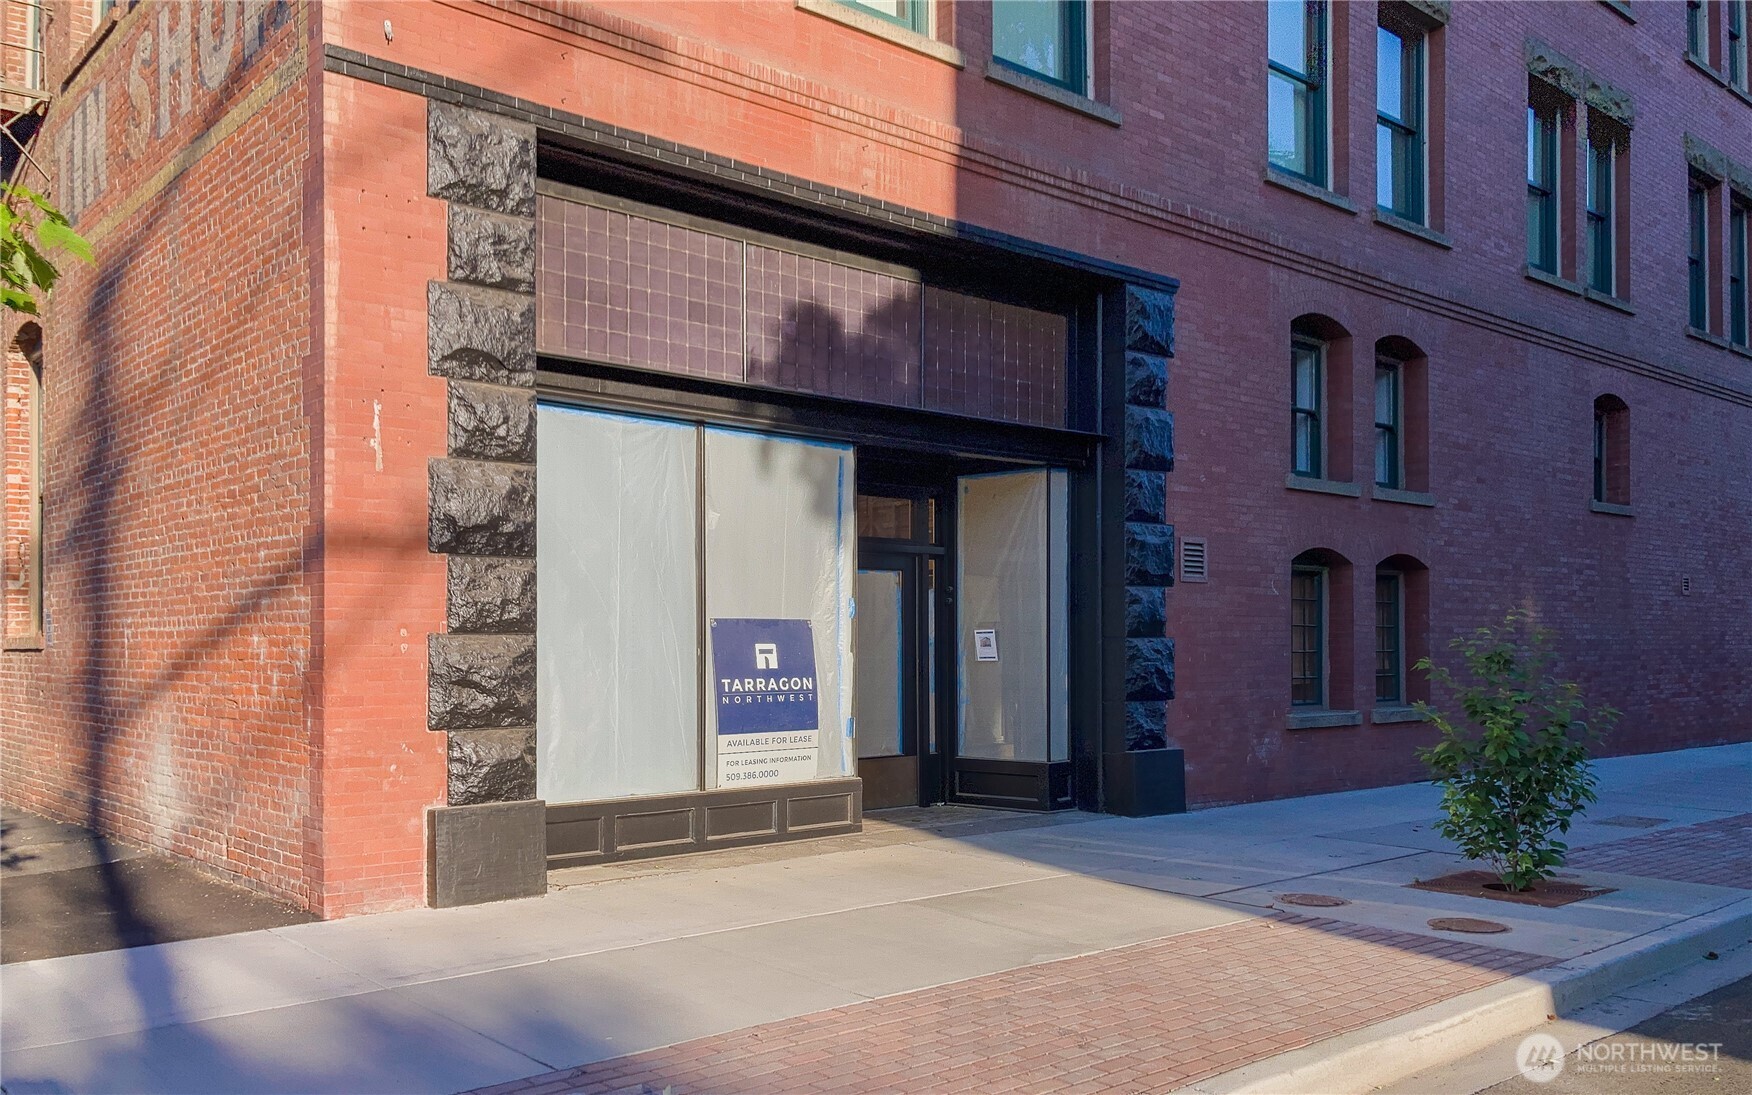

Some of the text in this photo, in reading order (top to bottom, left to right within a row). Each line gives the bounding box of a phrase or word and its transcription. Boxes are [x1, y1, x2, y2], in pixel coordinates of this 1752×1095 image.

[721, 677, 813, 693] TARRAGON
[722, 693, 814, 704] NORTHWEST
[726, 735, 812, 748] AVAILABLE FOR LEASE
[741, 757, 768, 766] LEASING
[769, 754, 812, 764] INFORMATION
[726, 769, 779, 781] 509.386.0000
